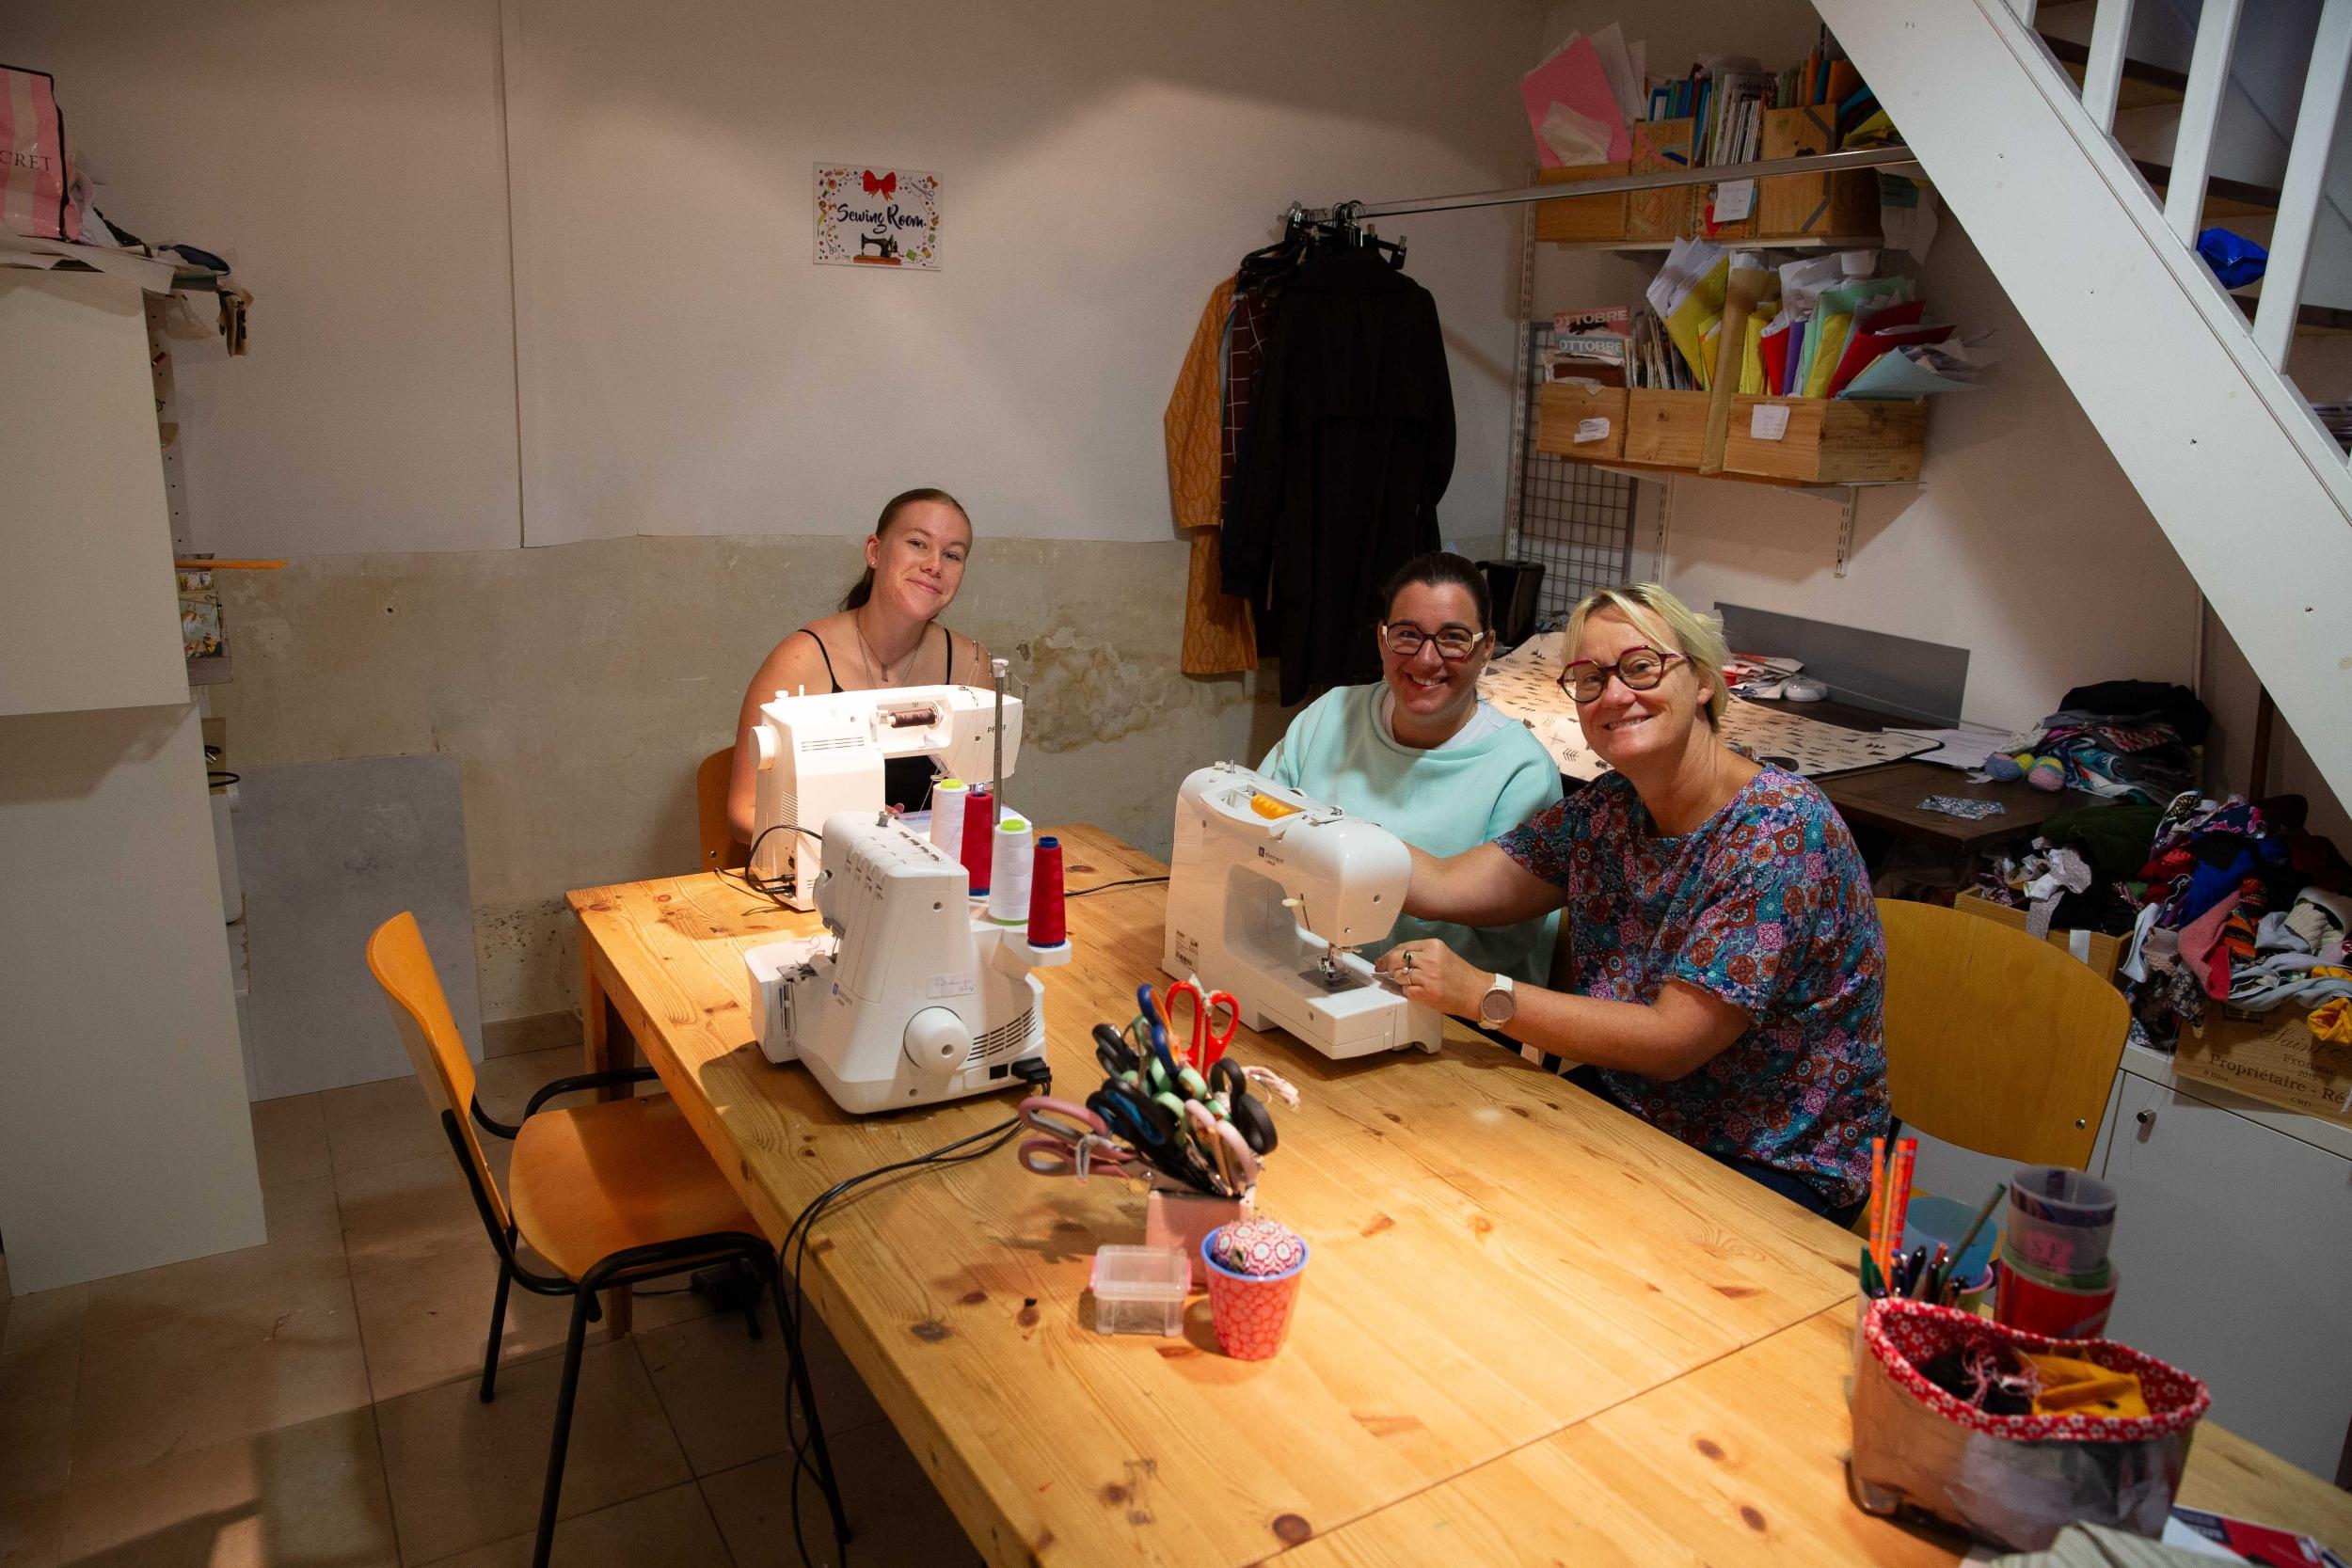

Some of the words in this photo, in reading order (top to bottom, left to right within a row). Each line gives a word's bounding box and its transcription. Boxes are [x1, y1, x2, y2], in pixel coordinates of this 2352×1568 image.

[836, 203, 887, 234] Sewing
[1554, 309, 1629, 327] OTTOBRE
[1559, 340, 1624, 354] OTTOBRE
[987, 724, 1007, 734] PFF
[2208, 1053, 2307, 1093] Propriétaire
[2322, 1087, 2349, 1105] Ré
